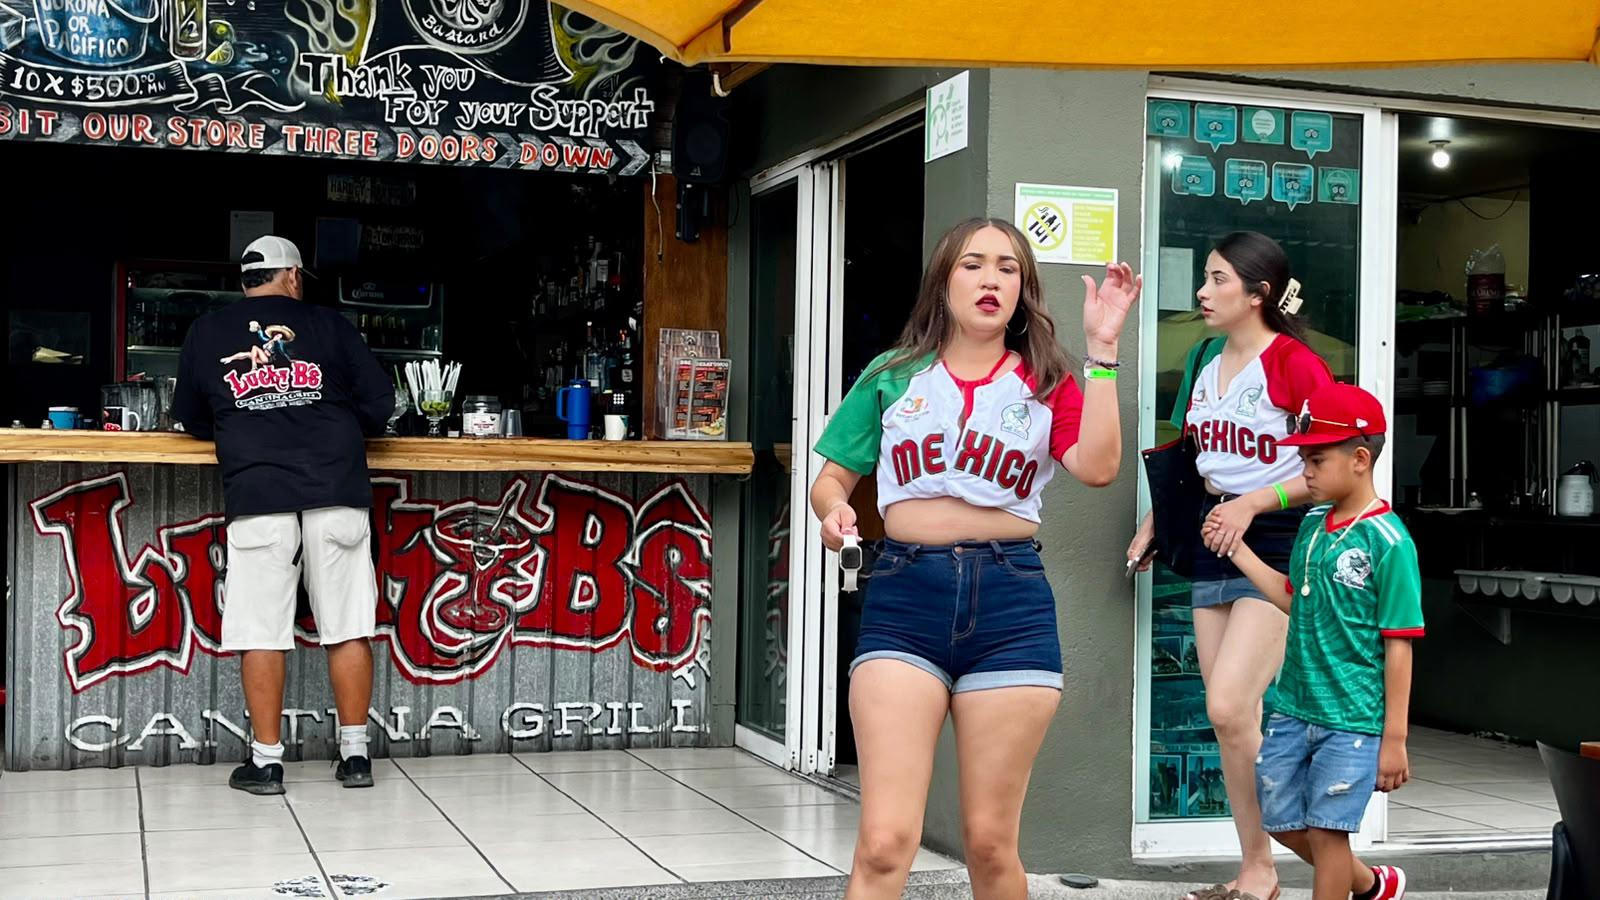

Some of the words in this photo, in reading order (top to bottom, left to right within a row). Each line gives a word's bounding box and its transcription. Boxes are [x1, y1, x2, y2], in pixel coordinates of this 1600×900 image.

[68, 15, 93, 34] OR
[422, 14, 506, 45] Bastard
[10, 66, 41, 92] 10
[301, 53, 415, 98] Thank
[420, 64, 476, 99] you
[381, 91, 448, 126] For
[455, 100, 527, 131] your
[528, 84, 655, 138] Support
[83, 112, 158, 143] OUR
[167, 116, 266, 149] STORE
[282, 125, 379, 156] THREE
[397, 131, 498, 162] DOORS
[519, 140, 613, 170] DOWN
[892, 429, 1038, 499] MEXICO
[502, 697, 710, 739] GRILL
